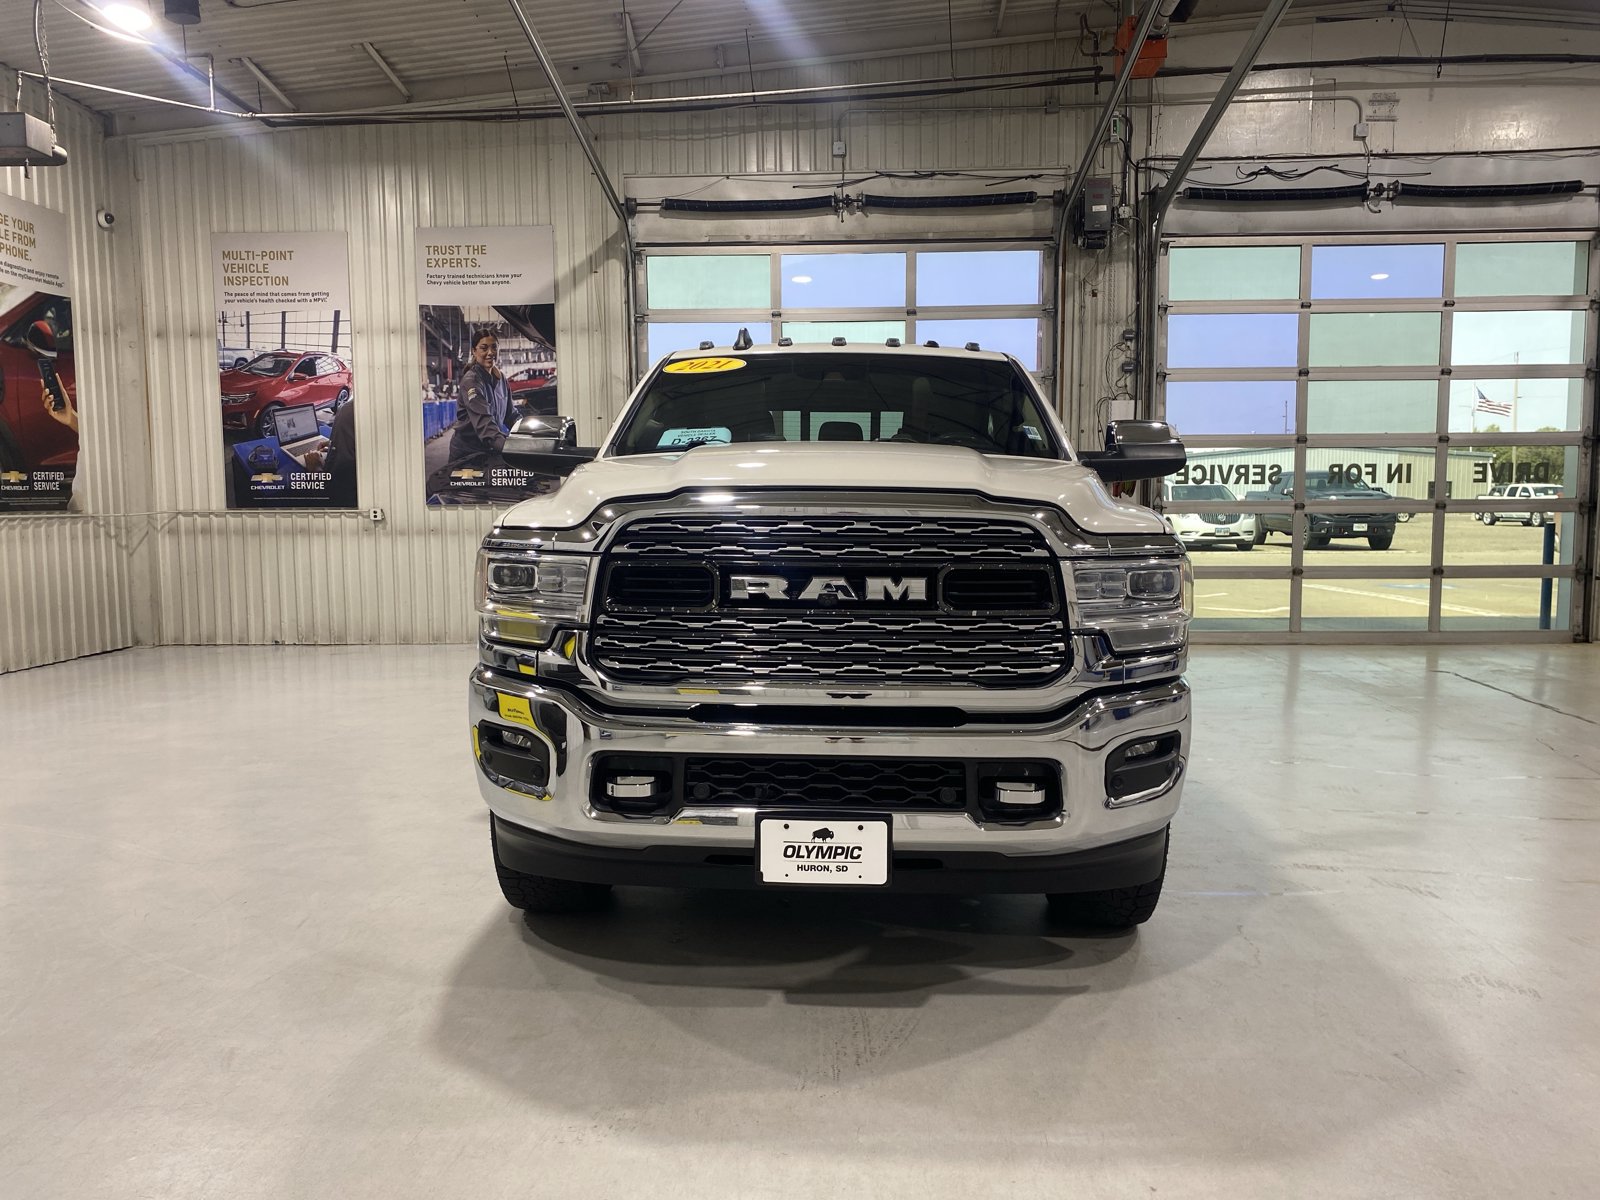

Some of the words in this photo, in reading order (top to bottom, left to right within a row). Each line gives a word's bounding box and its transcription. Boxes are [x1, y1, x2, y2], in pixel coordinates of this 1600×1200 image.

[11, 216, 34, 234] YOUR
[12, 232, 36, 248] FROM
[0, 242, 32, 262] PHONE.
[222, 250, 294, 260] MULTI-POINT
[426, 245, 462, 255] TRUST
[465, 245, 487, 255] THE
[222, 263, 269, 273] VEHICLE
[426, 258, 480, 268] EXPERTS.
[224, 276, 289, 286] INSPECTION
[674, 360, 734, 371] 2021
[33, 472, 65, 480] CERTIFIED
[34, 482, 60, 490] SERVICE
[730, 574, 927, 600] RAM
[783, 845, 862, 860] OLYMPIC
[797, 865, 832, 873] HURON,
